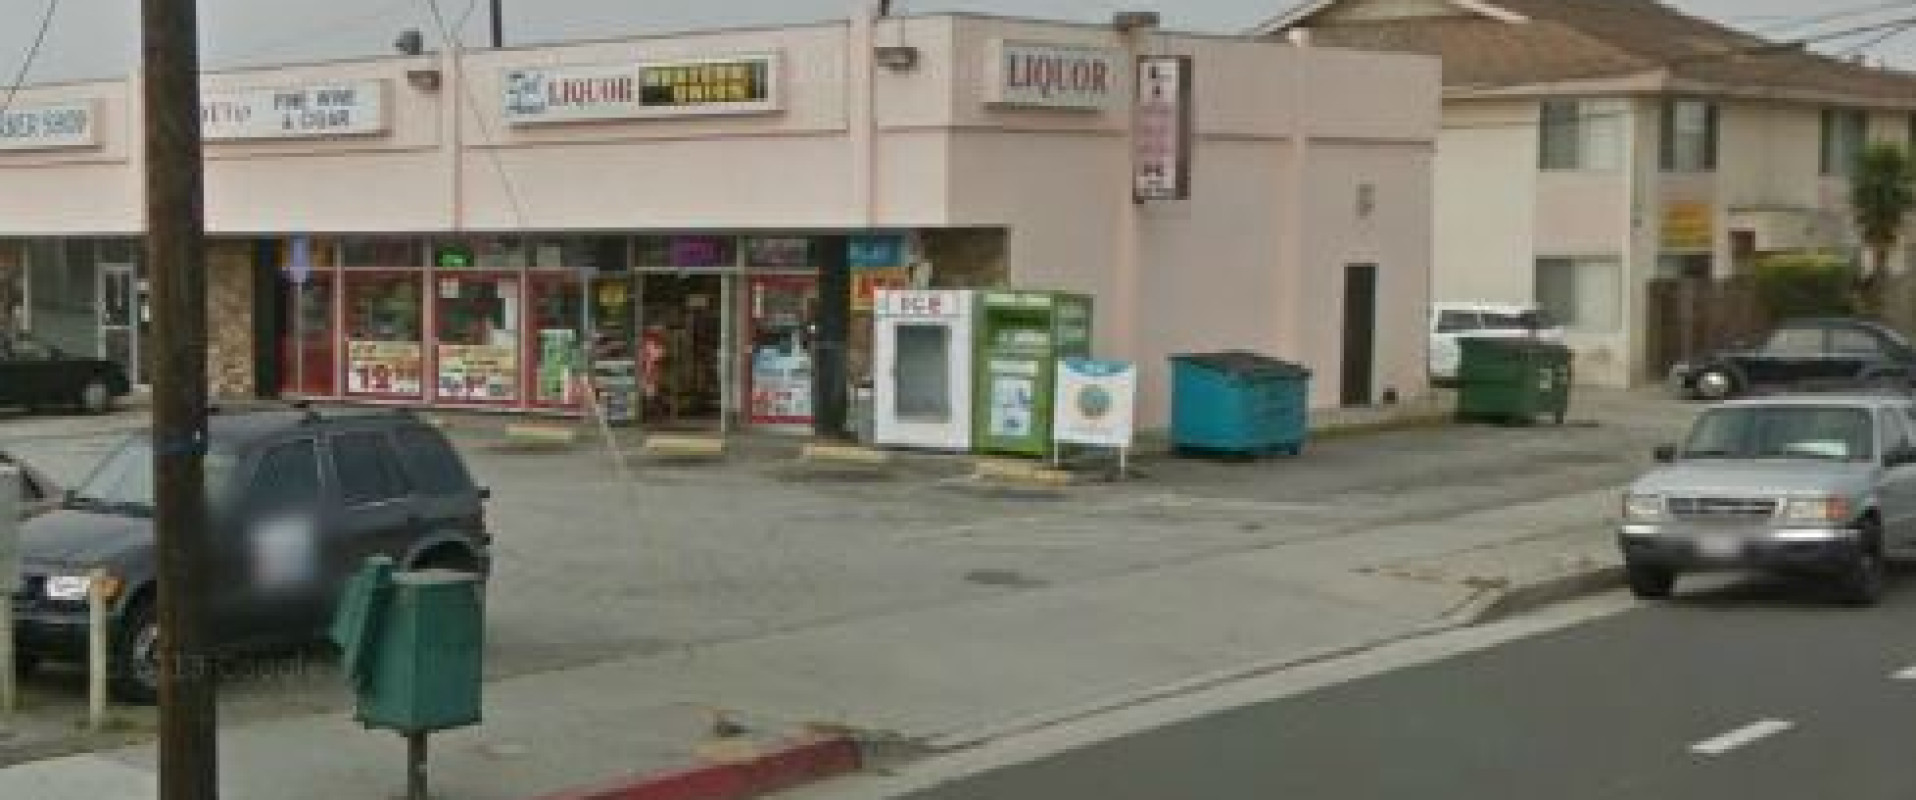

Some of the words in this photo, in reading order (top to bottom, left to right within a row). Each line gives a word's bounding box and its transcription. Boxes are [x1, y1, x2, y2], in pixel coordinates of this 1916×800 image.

[1007, 52, 1108, 98] LIQUOR
[273, 91, 306, 111] FINE
[315, 88, 355, 107] WINE
[548, 77, 633, 108] LIQUOR
[900, 296, 942, 316] ICE
